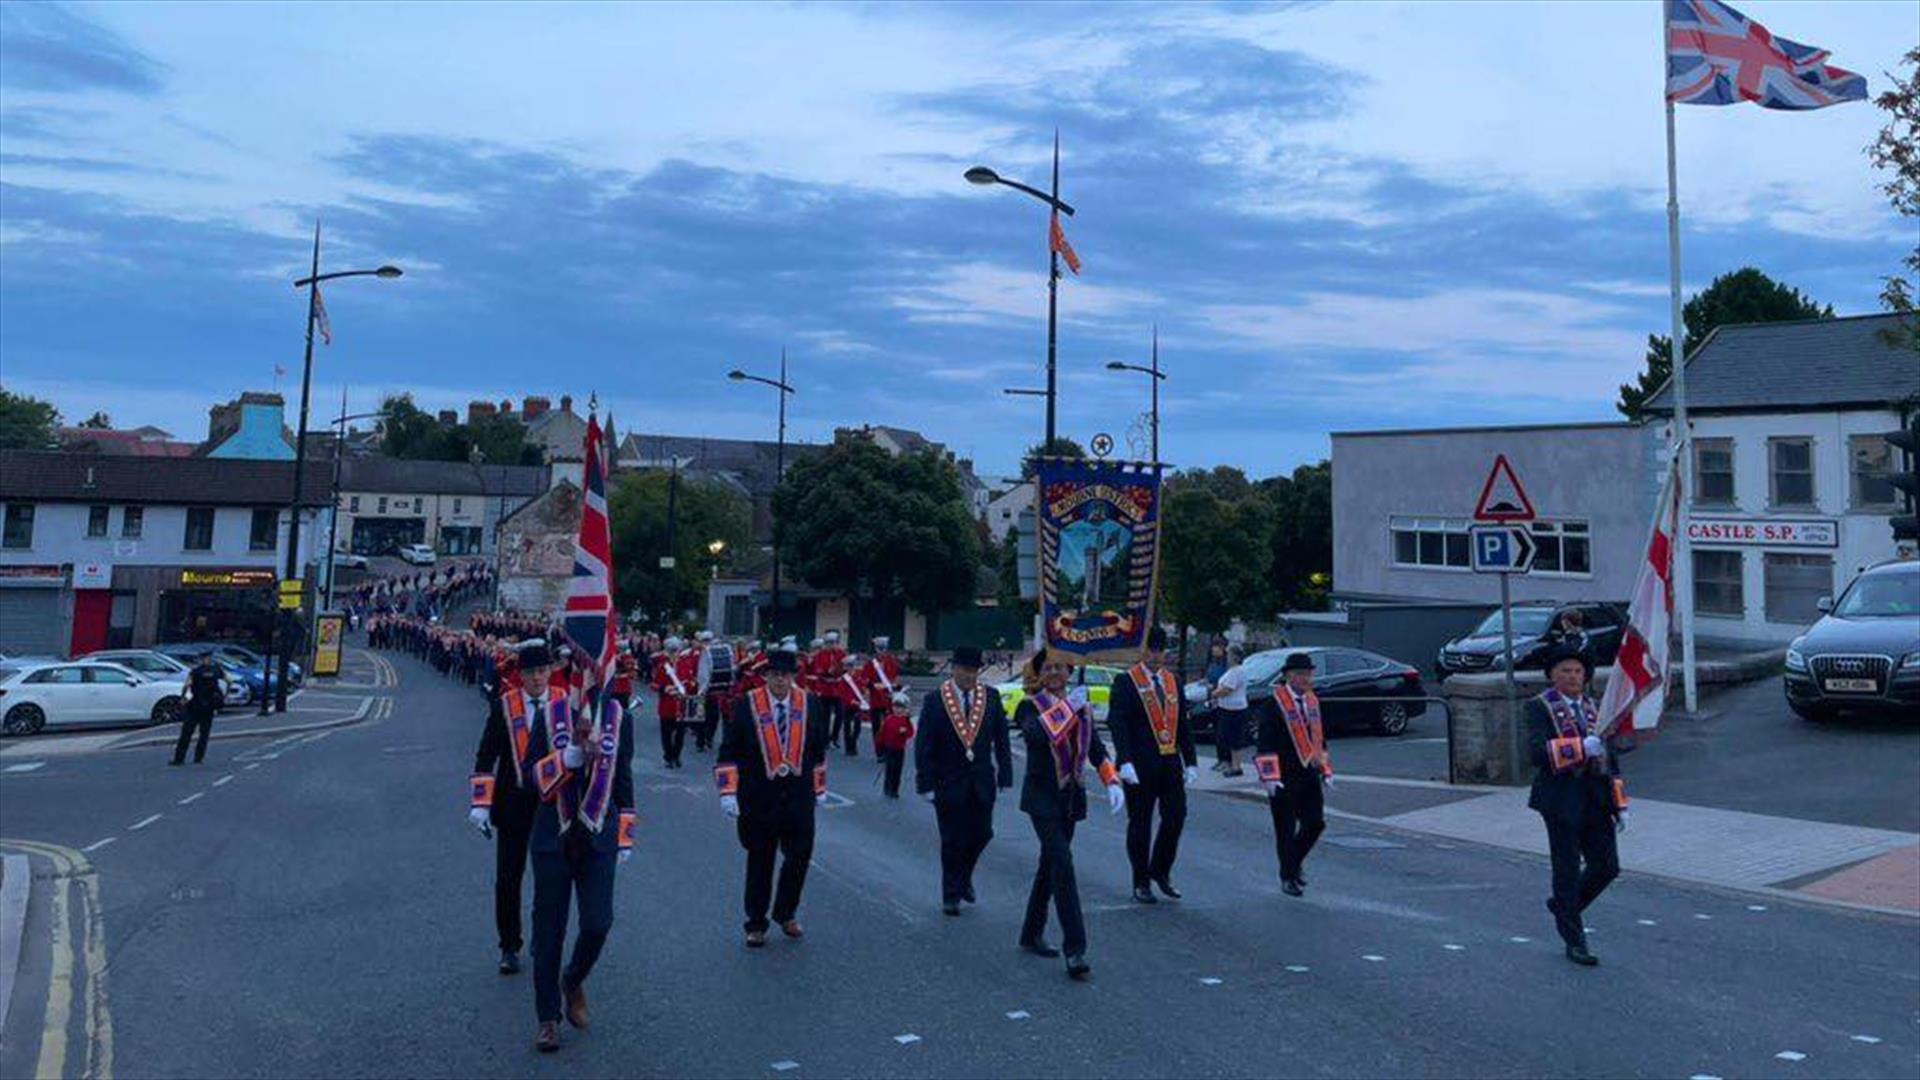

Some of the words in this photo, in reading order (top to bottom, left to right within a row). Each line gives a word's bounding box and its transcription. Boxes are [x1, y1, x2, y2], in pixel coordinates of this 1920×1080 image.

[1688, 524, 1756, 539] CASTLE
[1763, 524, 1798, 540] S.P.
[1484, 535, 1502, 561] P
